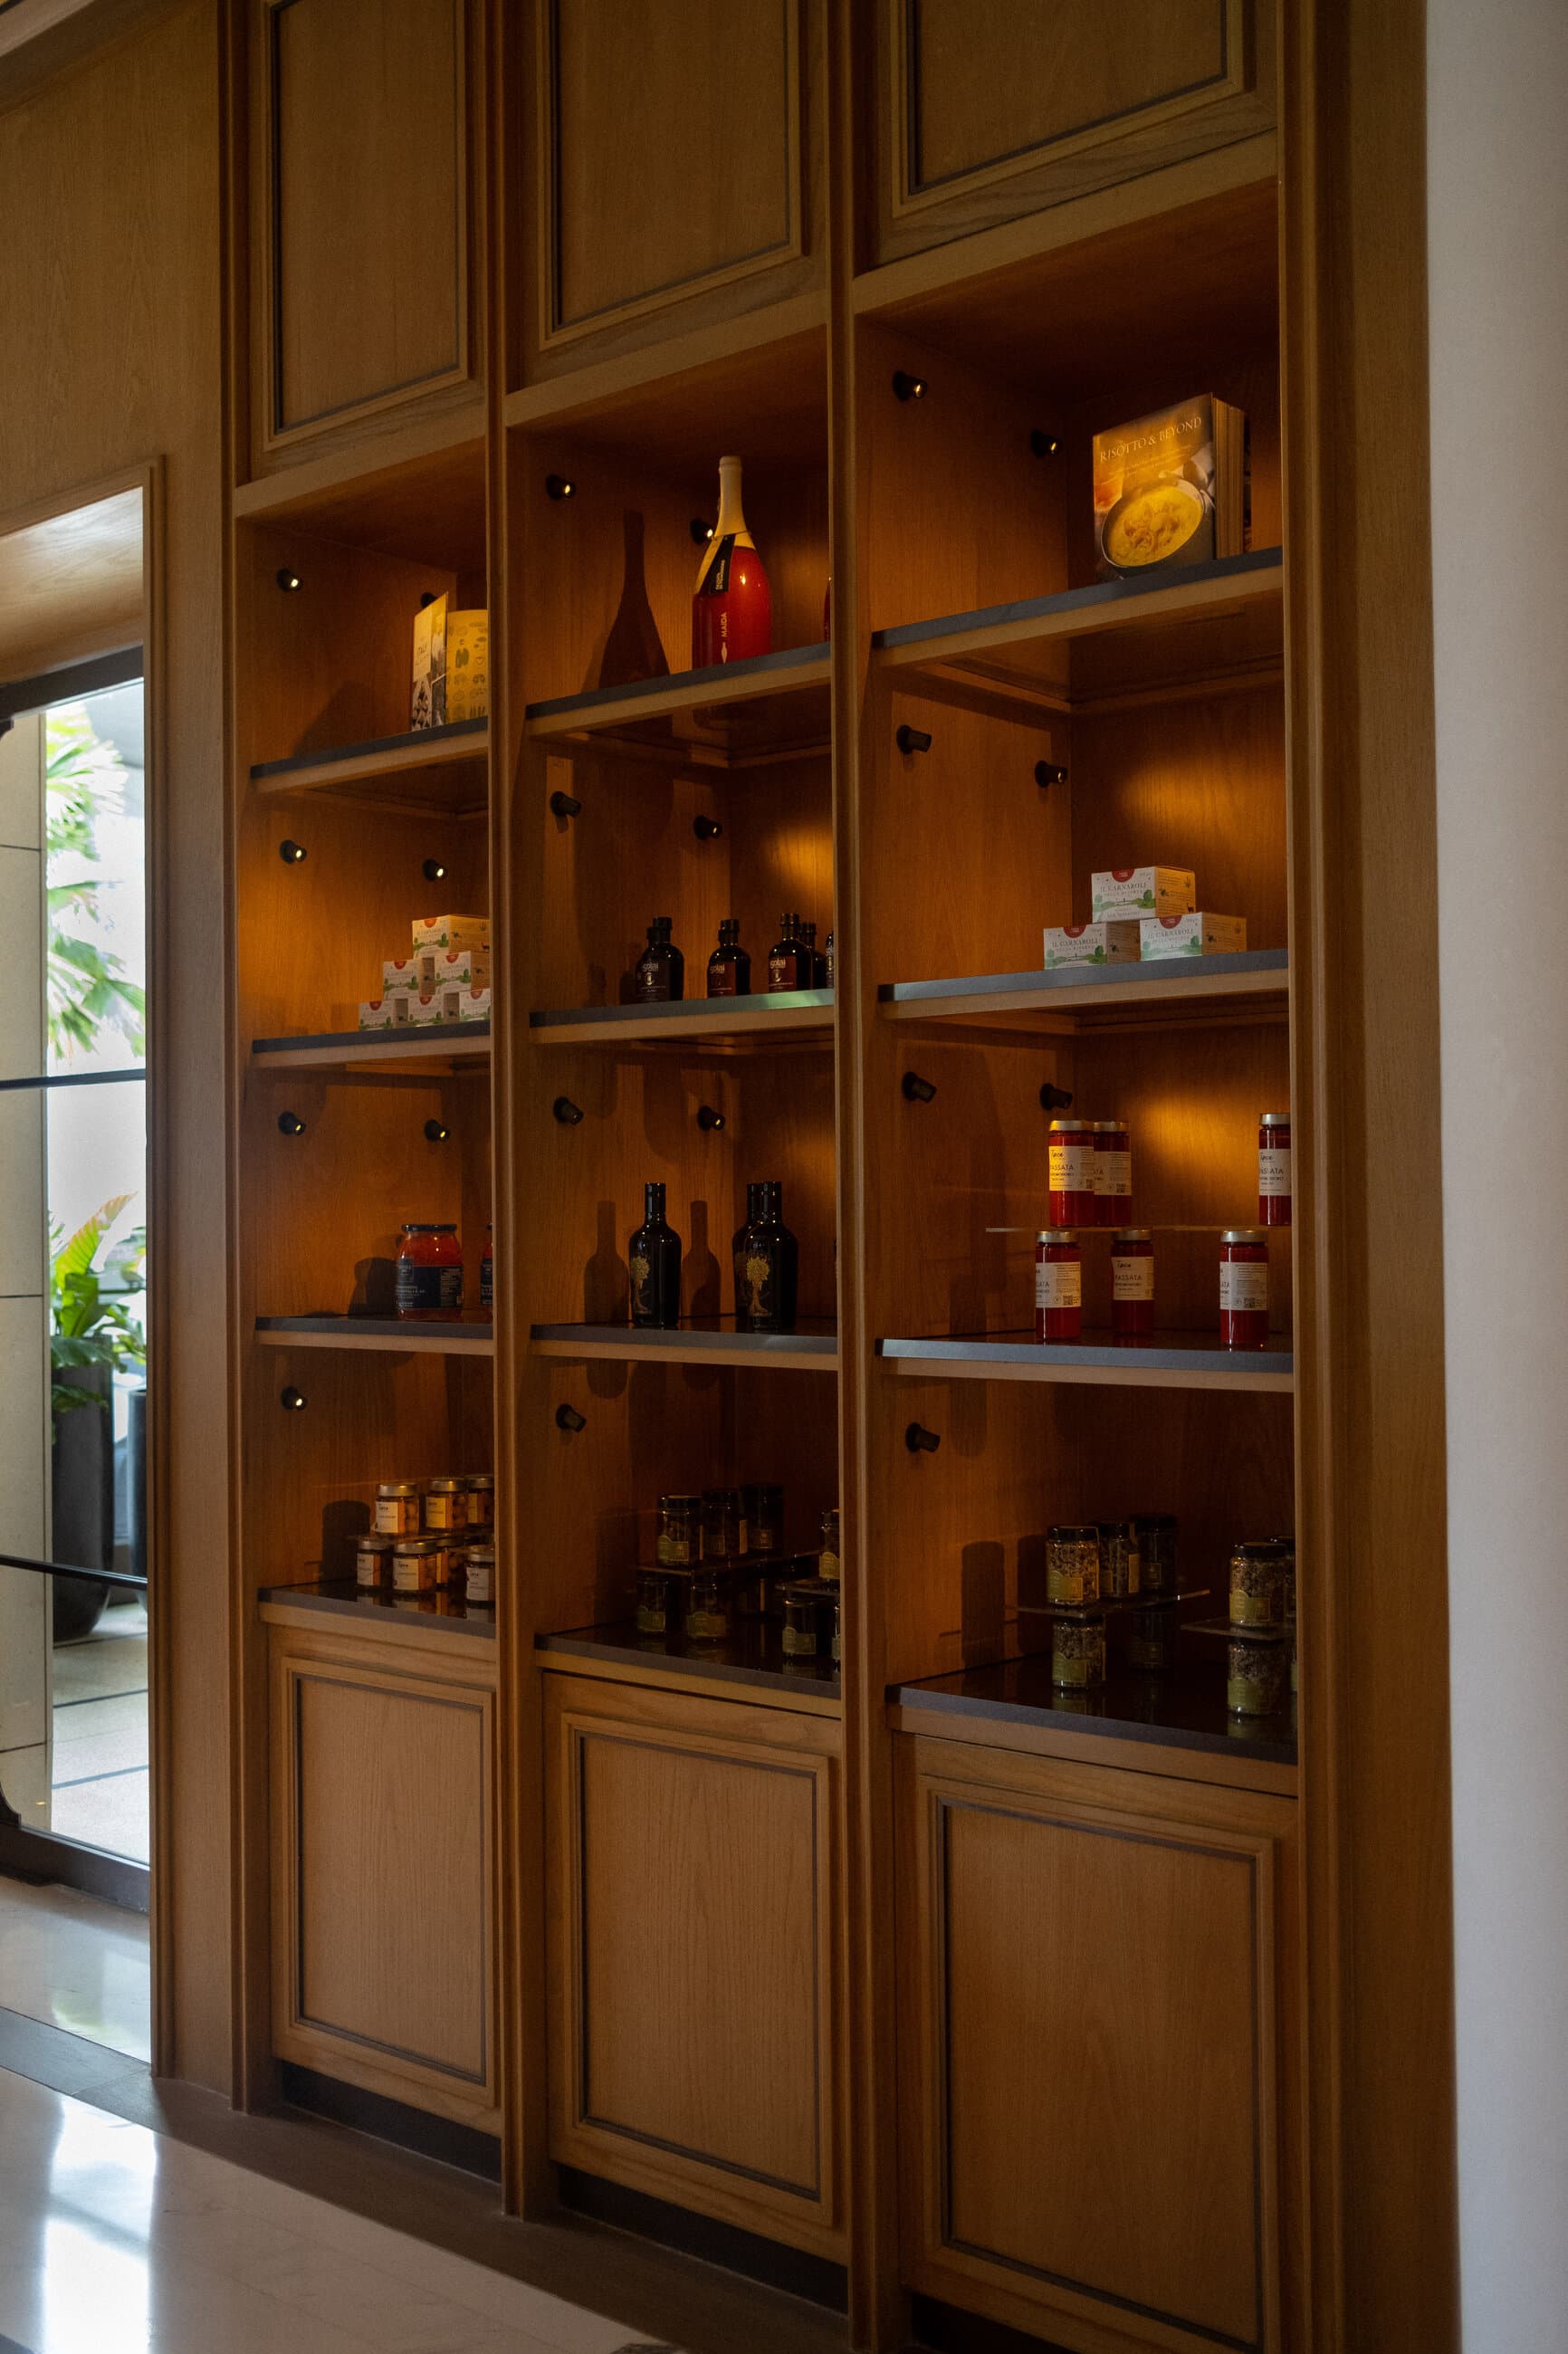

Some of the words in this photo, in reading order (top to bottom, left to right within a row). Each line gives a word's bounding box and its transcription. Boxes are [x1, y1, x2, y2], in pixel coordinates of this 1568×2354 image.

[1100, 437, 1147, 463] RISOTTO
[1148, 435, 1157, 445] &
[1159, 416, 1202, 441] BEYOND
[1108, 882, 1146, 893] CARNAROLI
[1060, 938, 1098, 947] CARNAROLI
